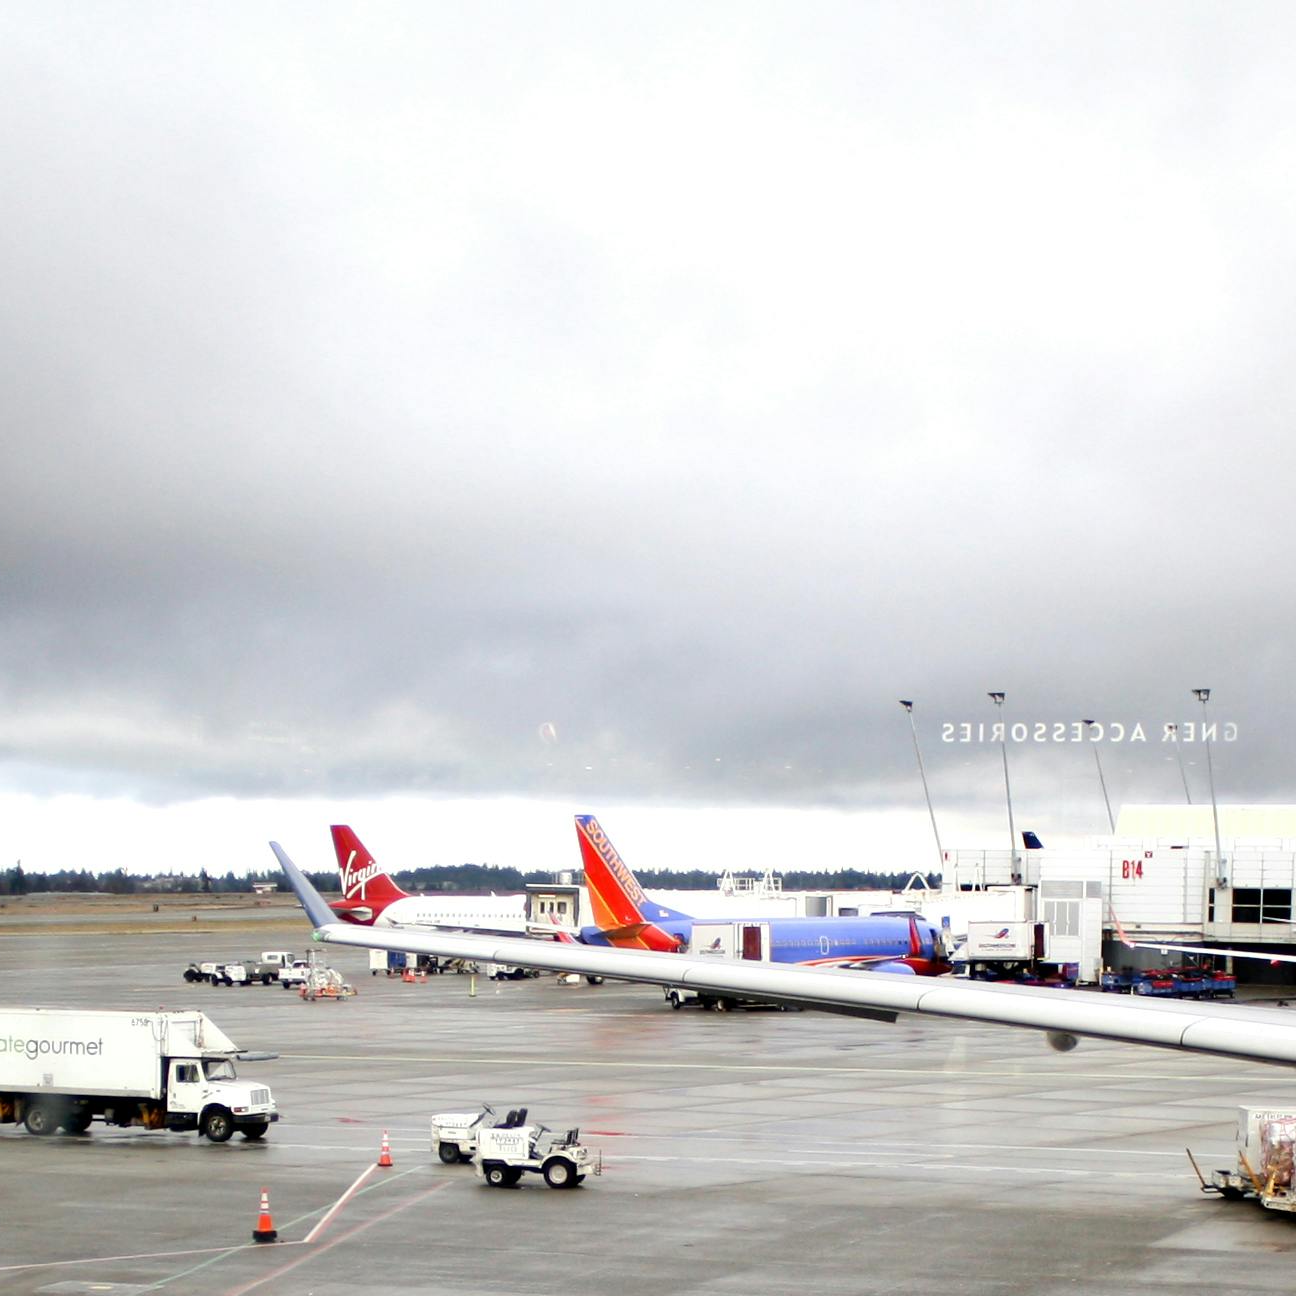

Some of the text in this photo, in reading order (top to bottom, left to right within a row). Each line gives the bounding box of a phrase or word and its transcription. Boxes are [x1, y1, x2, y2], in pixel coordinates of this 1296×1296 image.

[339, 849, 383, 901] Virgin
[586, 819, 647, 906] SOUTHWEST
[1122, 860, 1144, 879] B14
